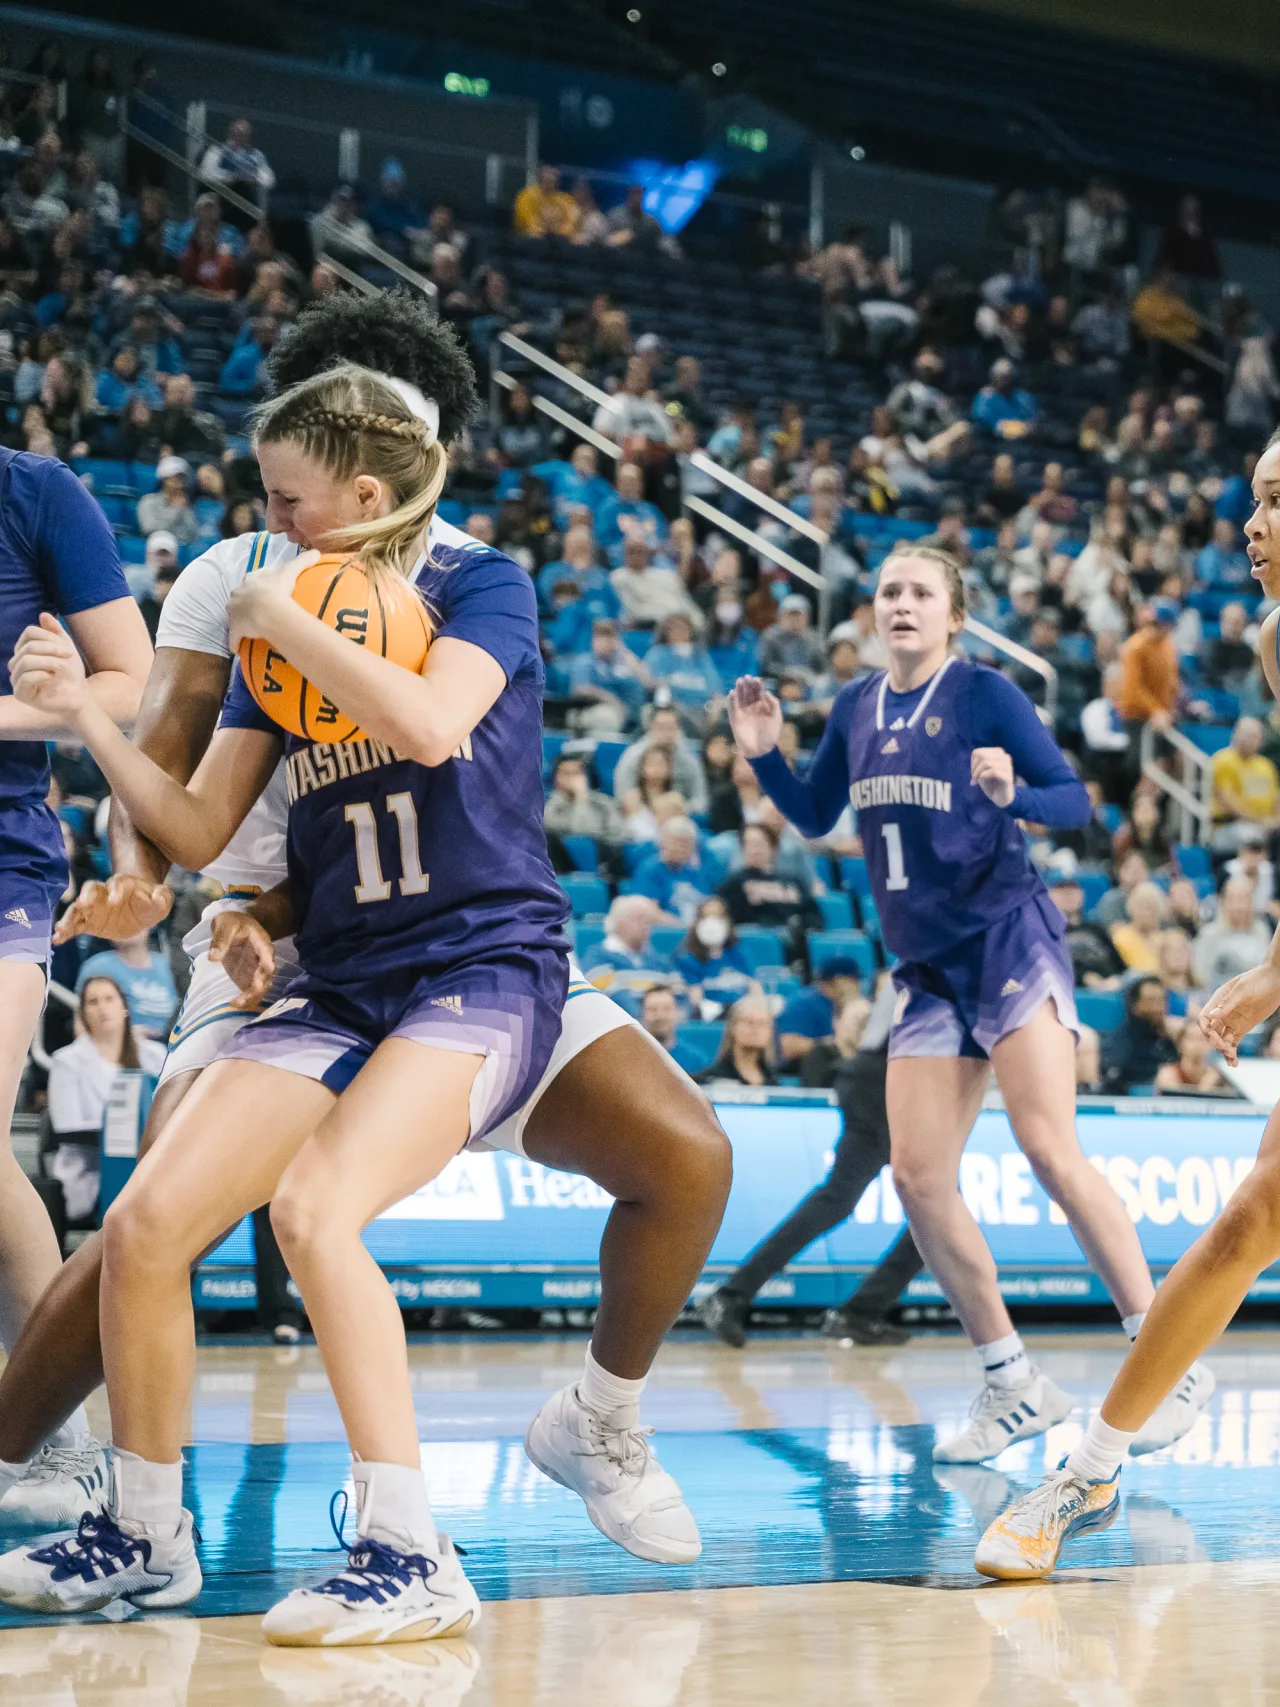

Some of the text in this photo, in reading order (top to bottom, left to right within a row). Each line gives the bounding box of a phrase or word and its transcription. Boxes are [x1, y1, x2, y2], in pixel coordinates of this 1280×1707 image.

[345, 791, 430, 903] 11
[882, 823, 909, 891] 1
[504, 1157, 616, 1208] Hea
